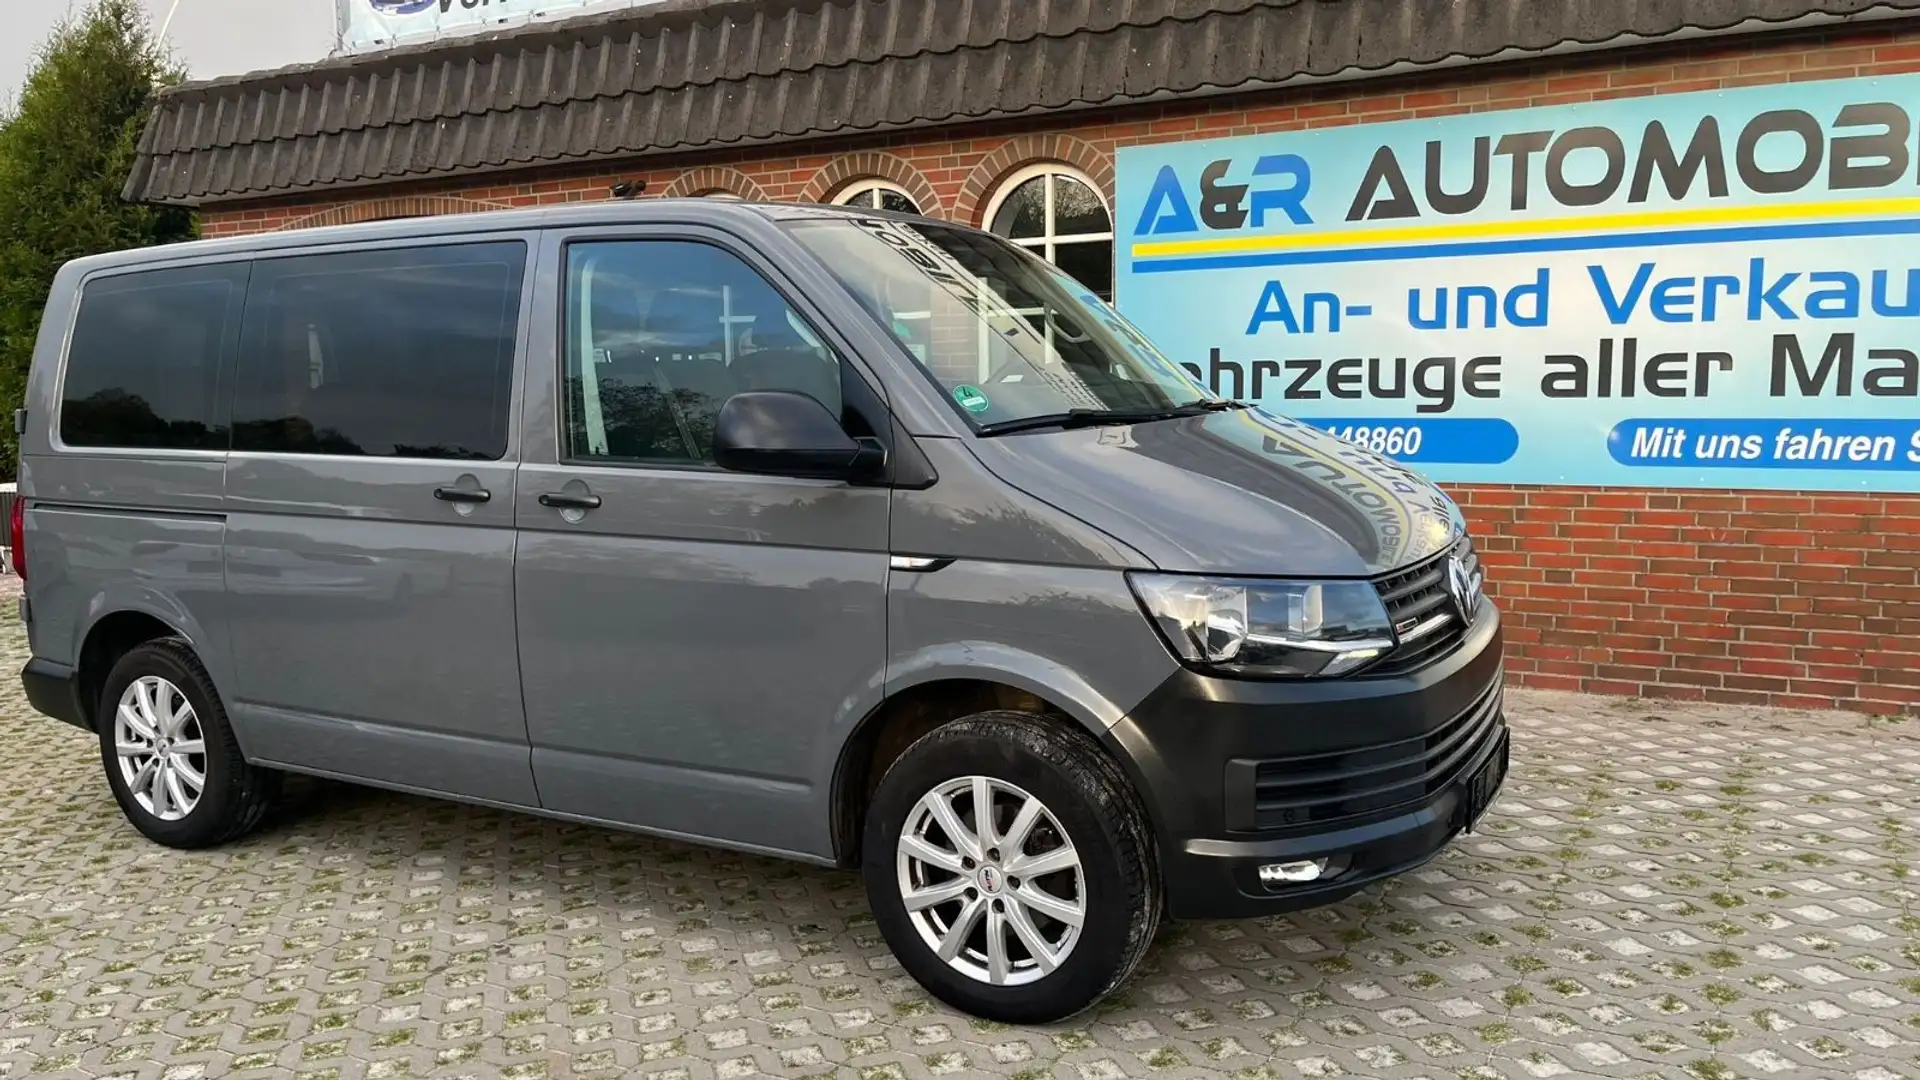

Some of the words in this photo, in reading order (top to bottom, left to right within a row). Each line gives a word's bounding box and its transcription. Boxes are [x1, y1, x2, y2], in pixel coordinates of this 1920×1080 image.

[1133, 154, 1314, 236] A&R
[1345, 102, 1920, 222] AUTOMOB
[1246, 279, 1372, 335] An-
[1408, 268, 1549, 330] und
[1179, 348, 1502, 413] hrzeuge
[1540, 338, 1733, 398] aller
[1631, 427, 1686, 458] Mit
[1695, 434, 1762, 459] uns
[1773, 428, 1896, 462] fahren
